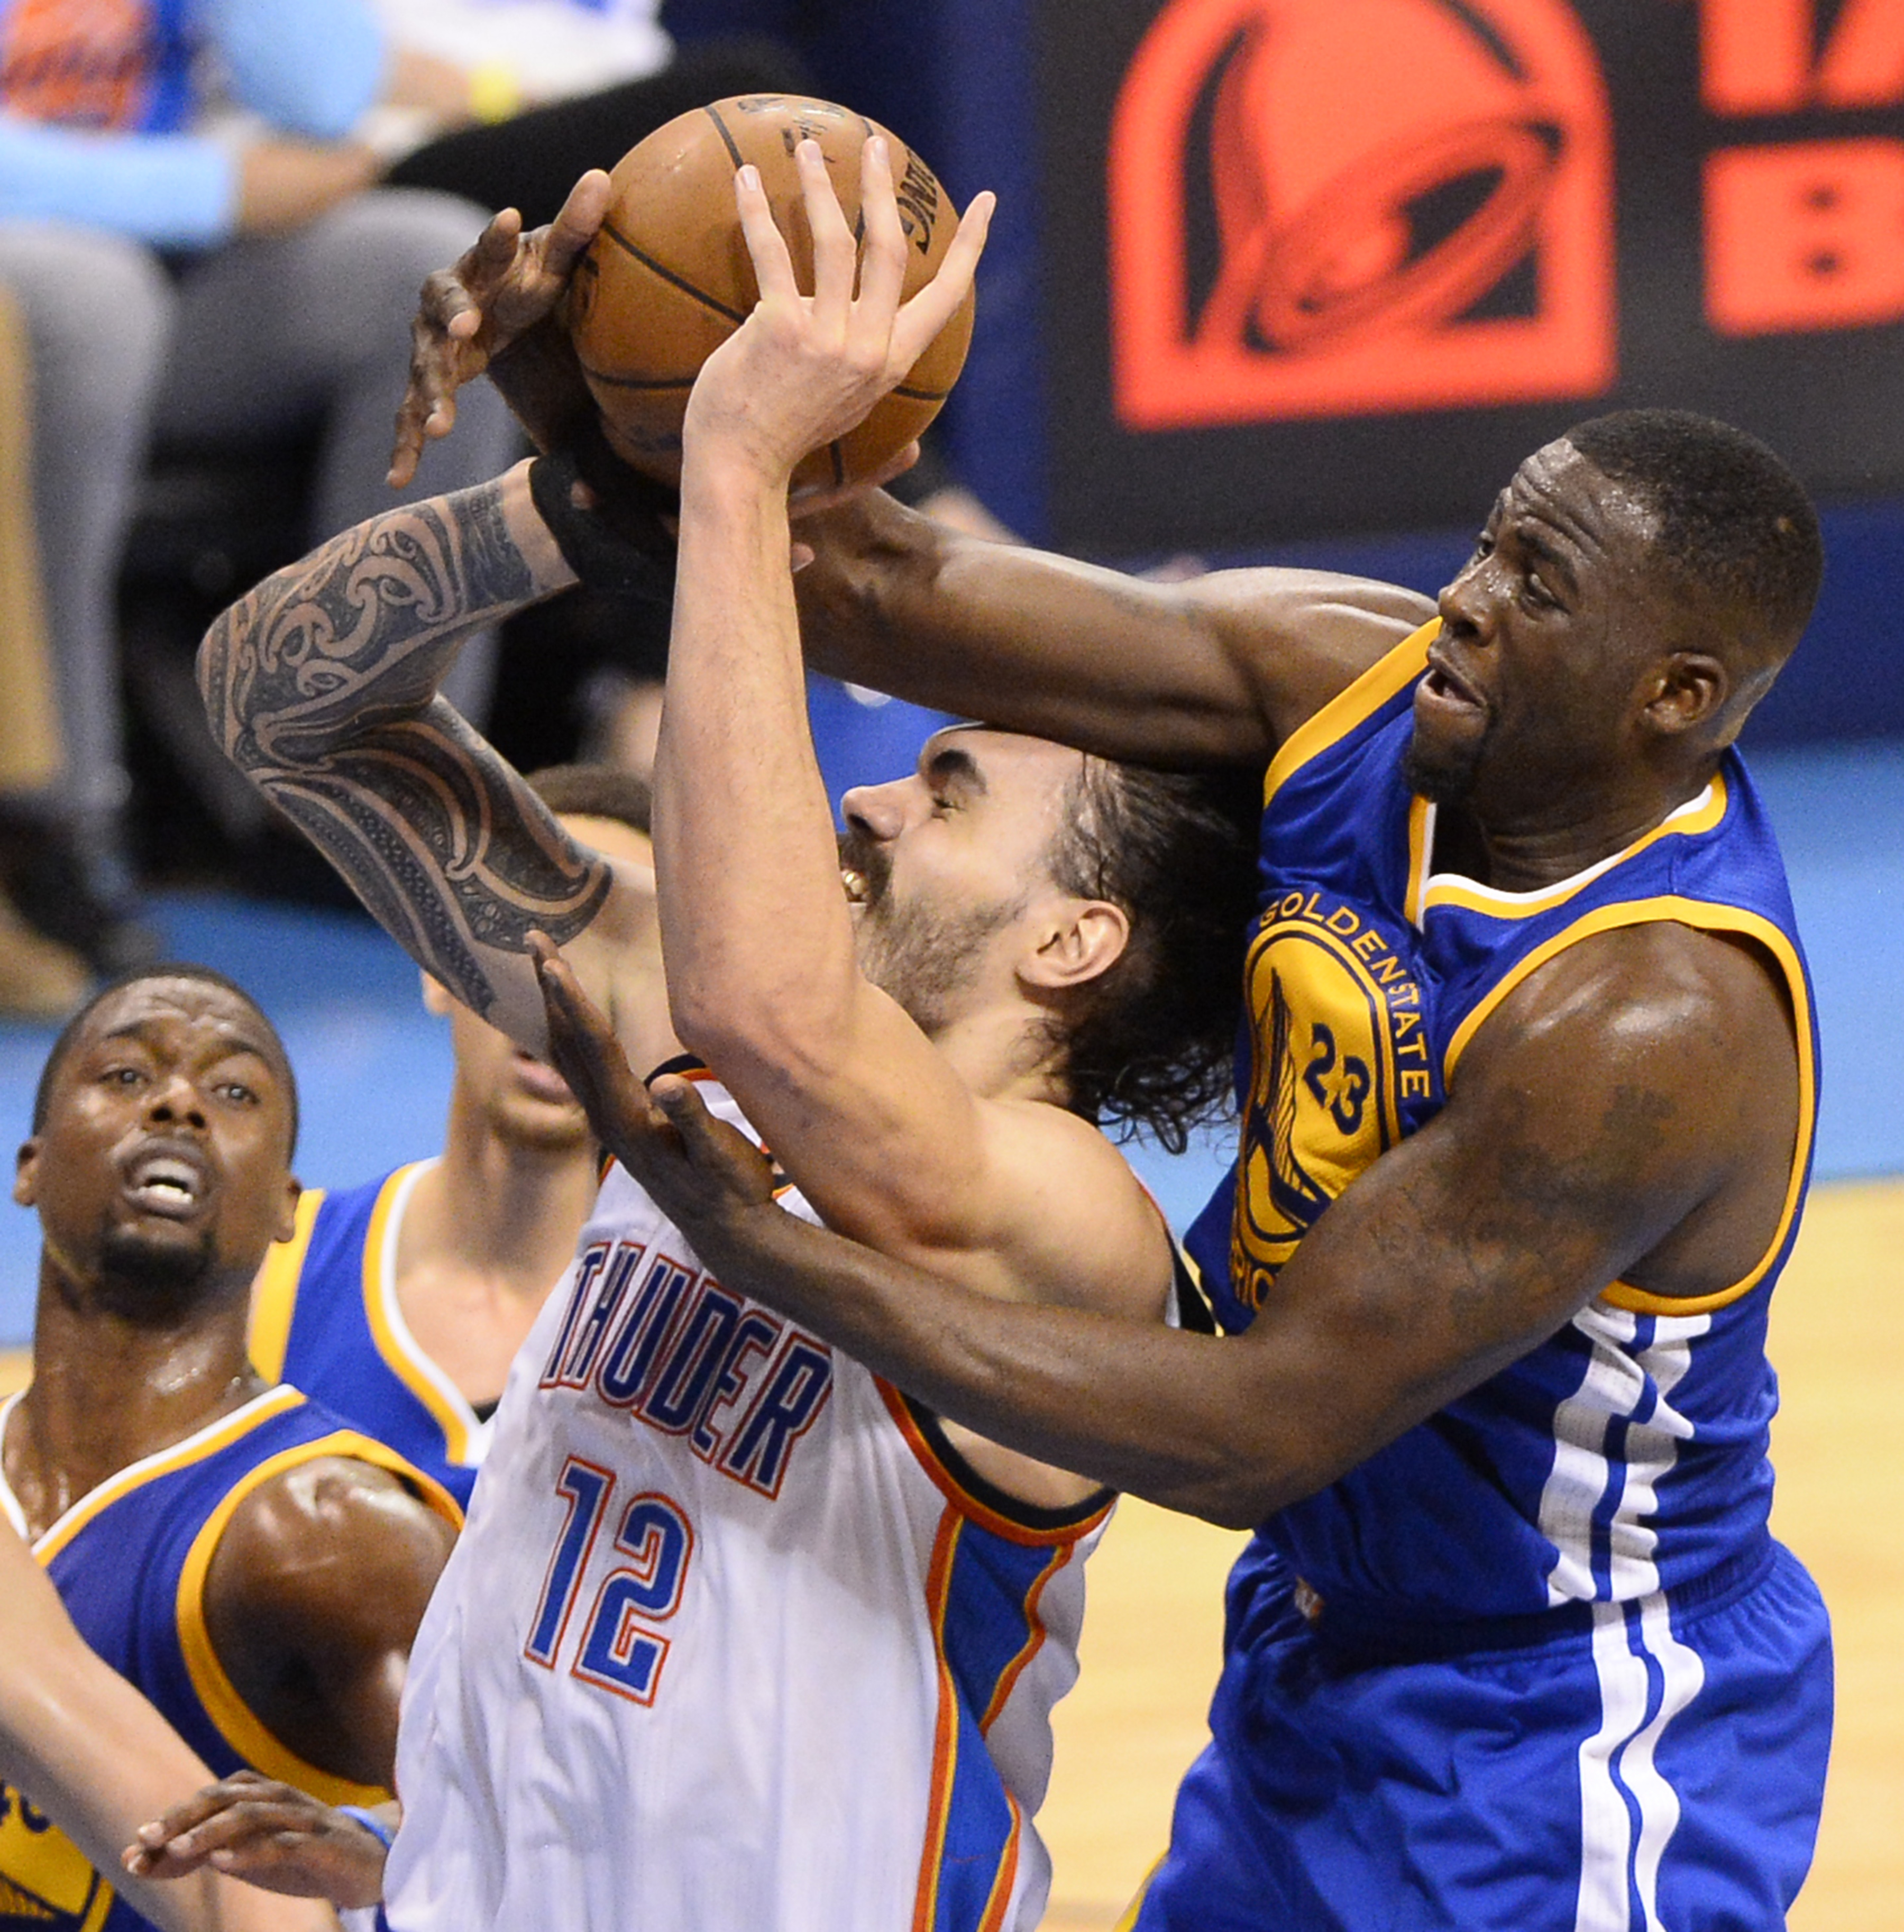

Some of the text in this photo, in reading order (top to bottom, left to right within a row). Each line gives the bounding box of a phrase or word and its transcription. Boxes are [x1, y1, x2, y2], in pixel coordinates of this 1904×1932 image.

[1259, 892, 1430, 1098] GOLDEN STATE
[1303, 1022, 1371, 1136] 23
[524, 1454, 693, 1708] 12
